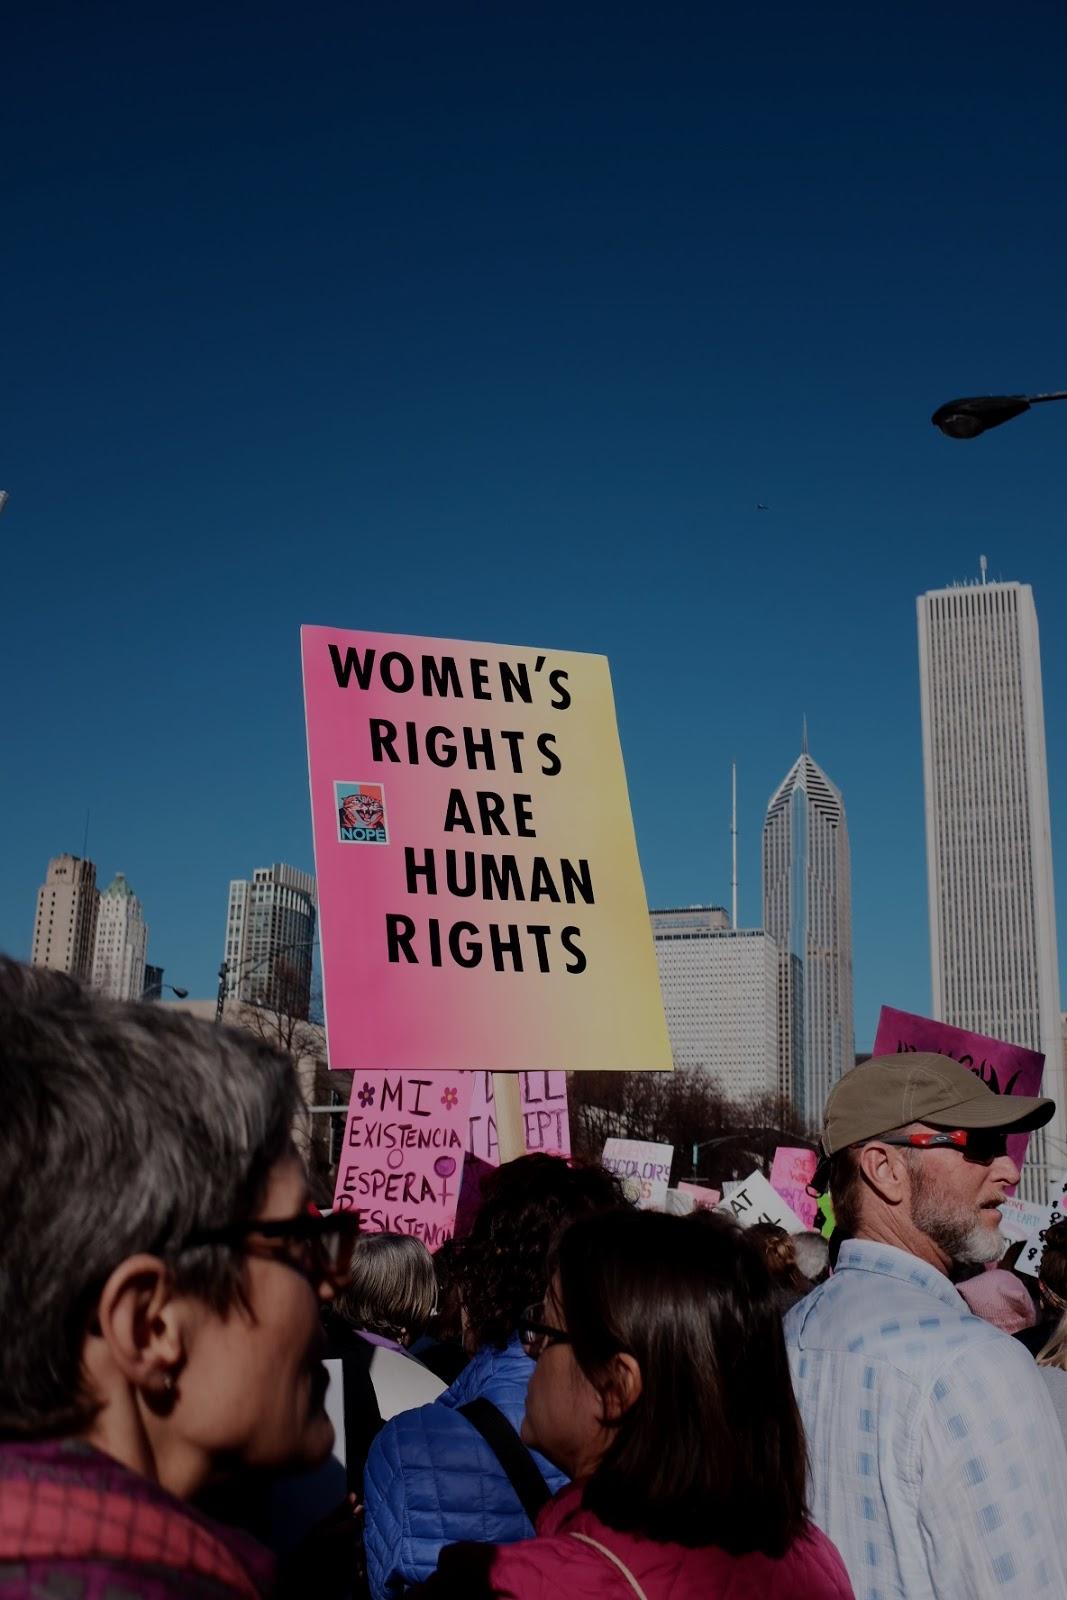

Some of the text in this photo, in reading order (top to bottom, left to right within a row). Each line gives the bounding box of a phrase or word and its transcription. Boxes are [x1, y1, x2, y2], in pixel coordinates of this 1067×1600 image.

[328, 644, 572, 711] WOMEN'S
[369, 718, 563, 776] RIGHTS
[341, 827, 387, 842] NOPE
[443, 788, 537, 838] ARE
[404, 846, 595, 905] HUMAN
[385, 913, 588, 975] RIGHTS
[379, 1075, 433, 1117] MI
[349, 1116, 462, 1149] EXISTENCIA
[343, 1166, 437, 1205] ESPERA
